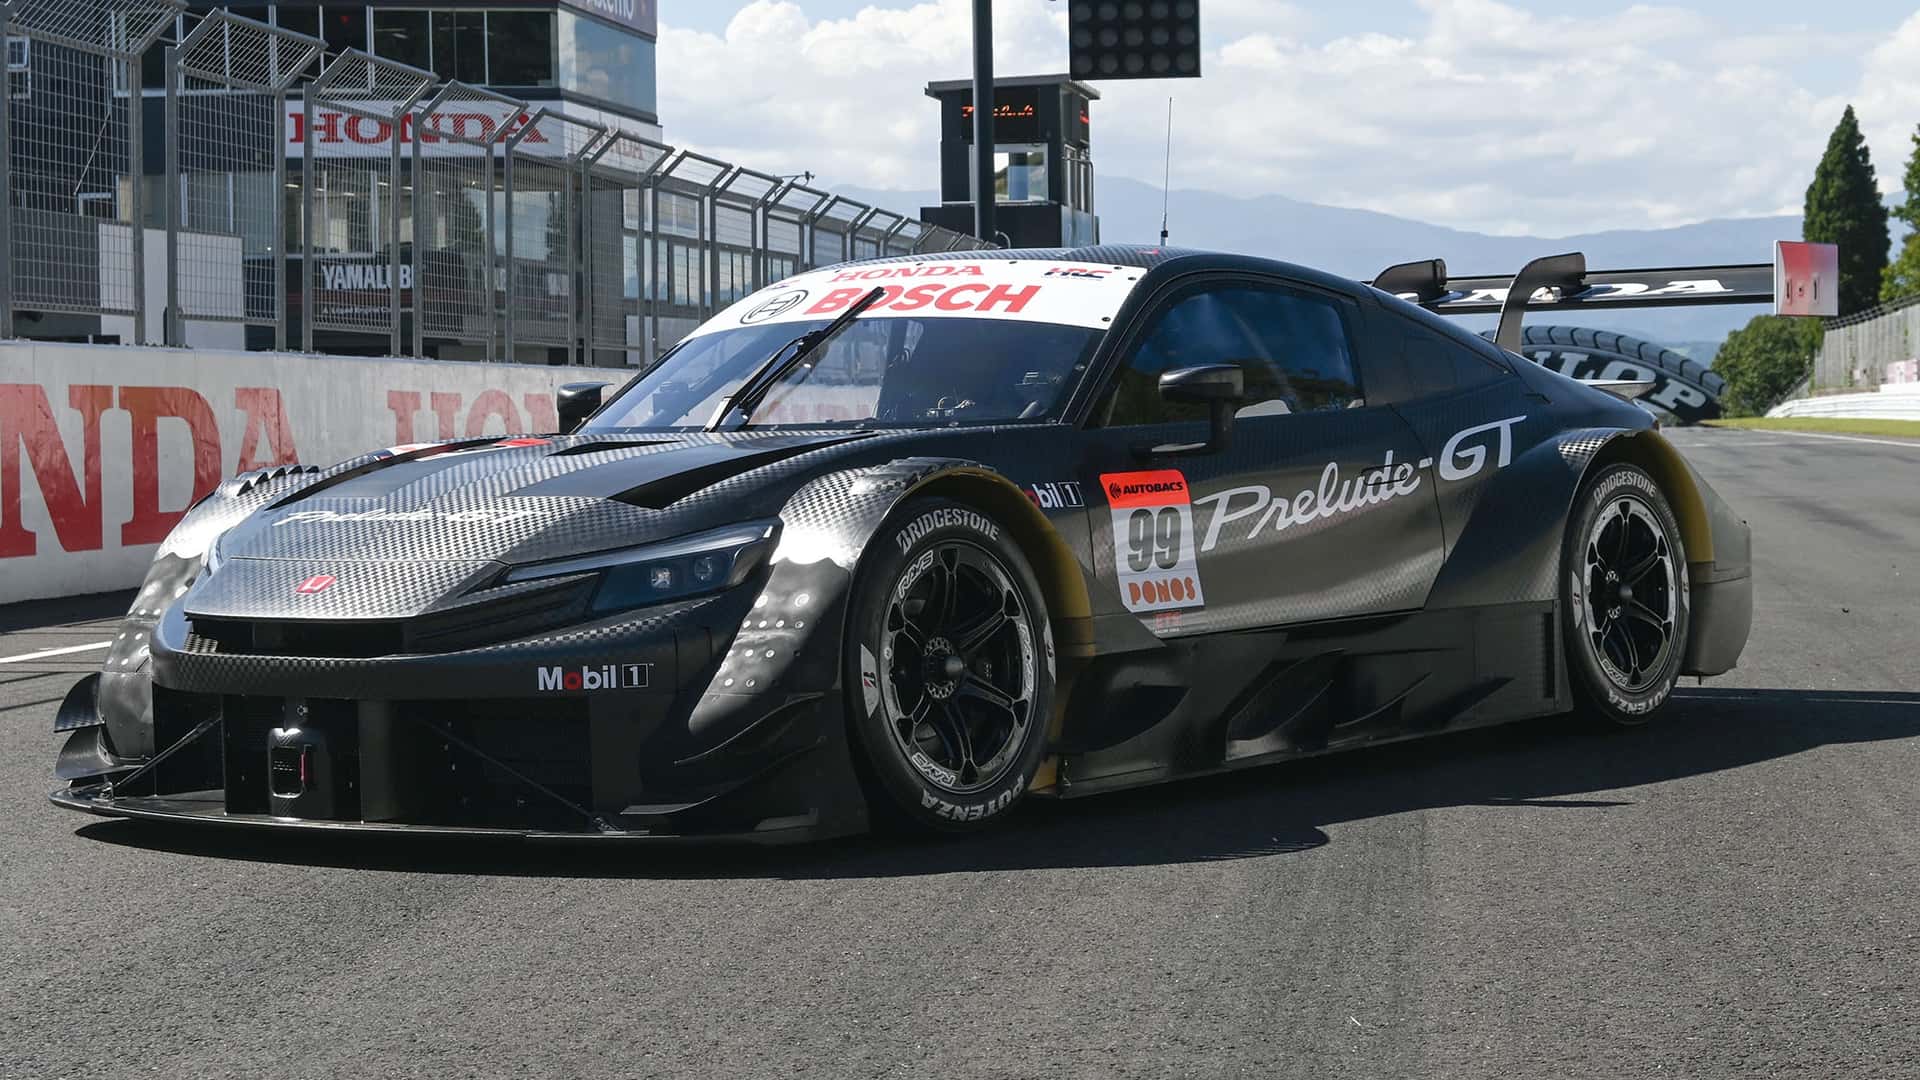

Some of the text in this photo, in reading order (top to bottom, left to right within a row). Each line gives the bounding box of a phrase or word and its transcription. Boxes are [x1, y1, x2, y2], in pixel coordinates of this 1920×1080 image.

[289, 112, 549, 144] HONDA
[321, 264, 414, 290] YAMALUB
[829, 264, 982, 283] HONDA
[802, 284, 1042, 316] BOSCH
[1123, 481, 1183, 495] AUTOBACS
[1193, 415, 1528, 553] Prelude-GT
[1593, 471, 1657, 506] BRIDGESTONE
[895, 508, 1000, 554] BRIDGESTONE
[1127, 506, 1182, 572] 99
[1128, 576, 1196, 606] PONOS
[537, 664, 617, 691] Mobil
[1608, 679, 1671, 716] POTENZA
[922, 774, 1025, 822] POTENZA
